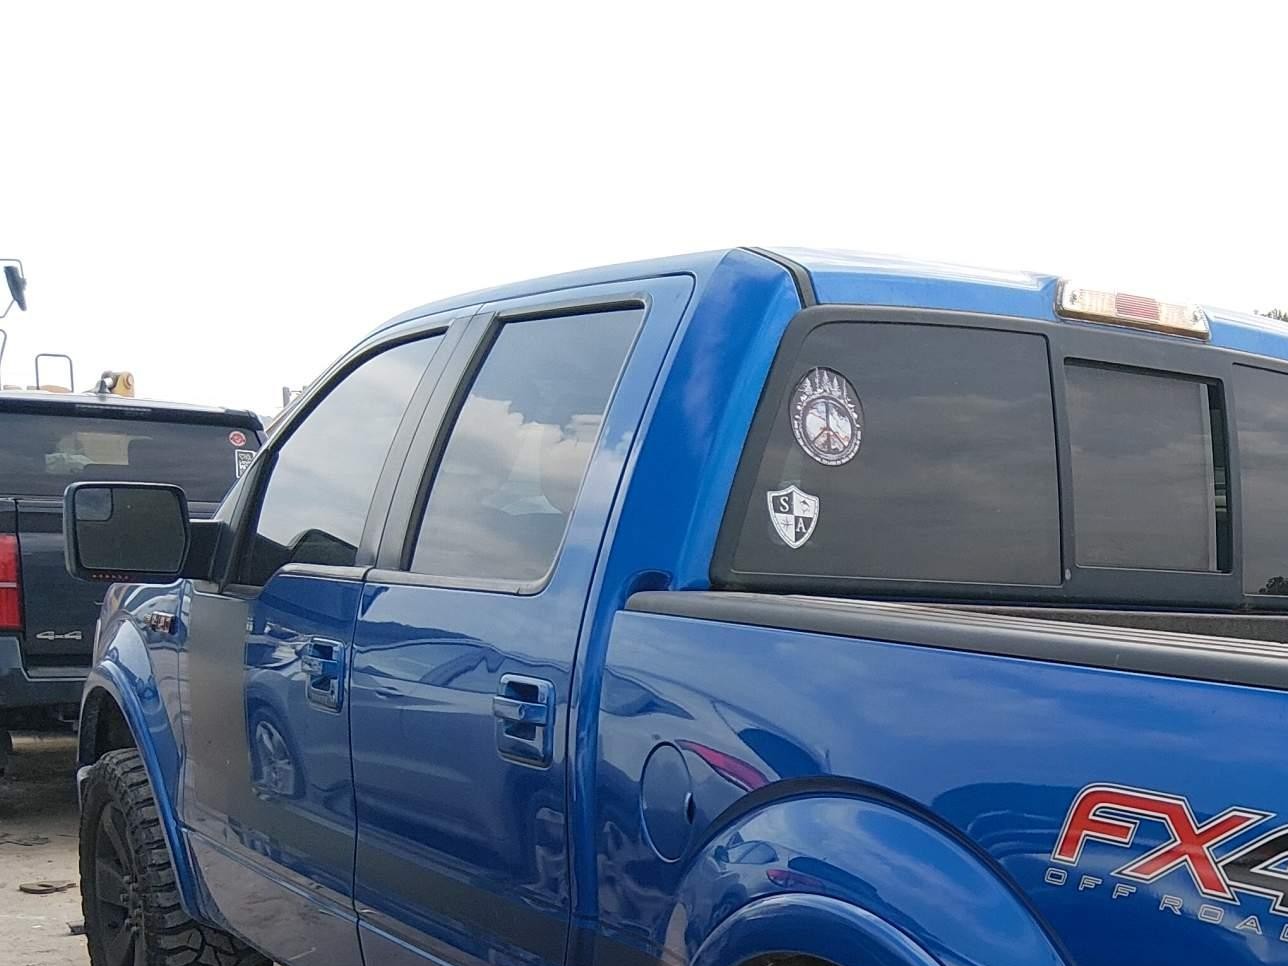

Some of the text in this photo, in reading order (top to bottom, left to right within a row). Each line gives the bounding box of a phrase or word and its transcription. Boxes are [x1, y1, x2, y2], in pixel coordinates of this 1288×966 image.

[779, 495, 790, 512] S
[795, 516, 807, 533] A
[1044, 867, 1136, 899] OFF
